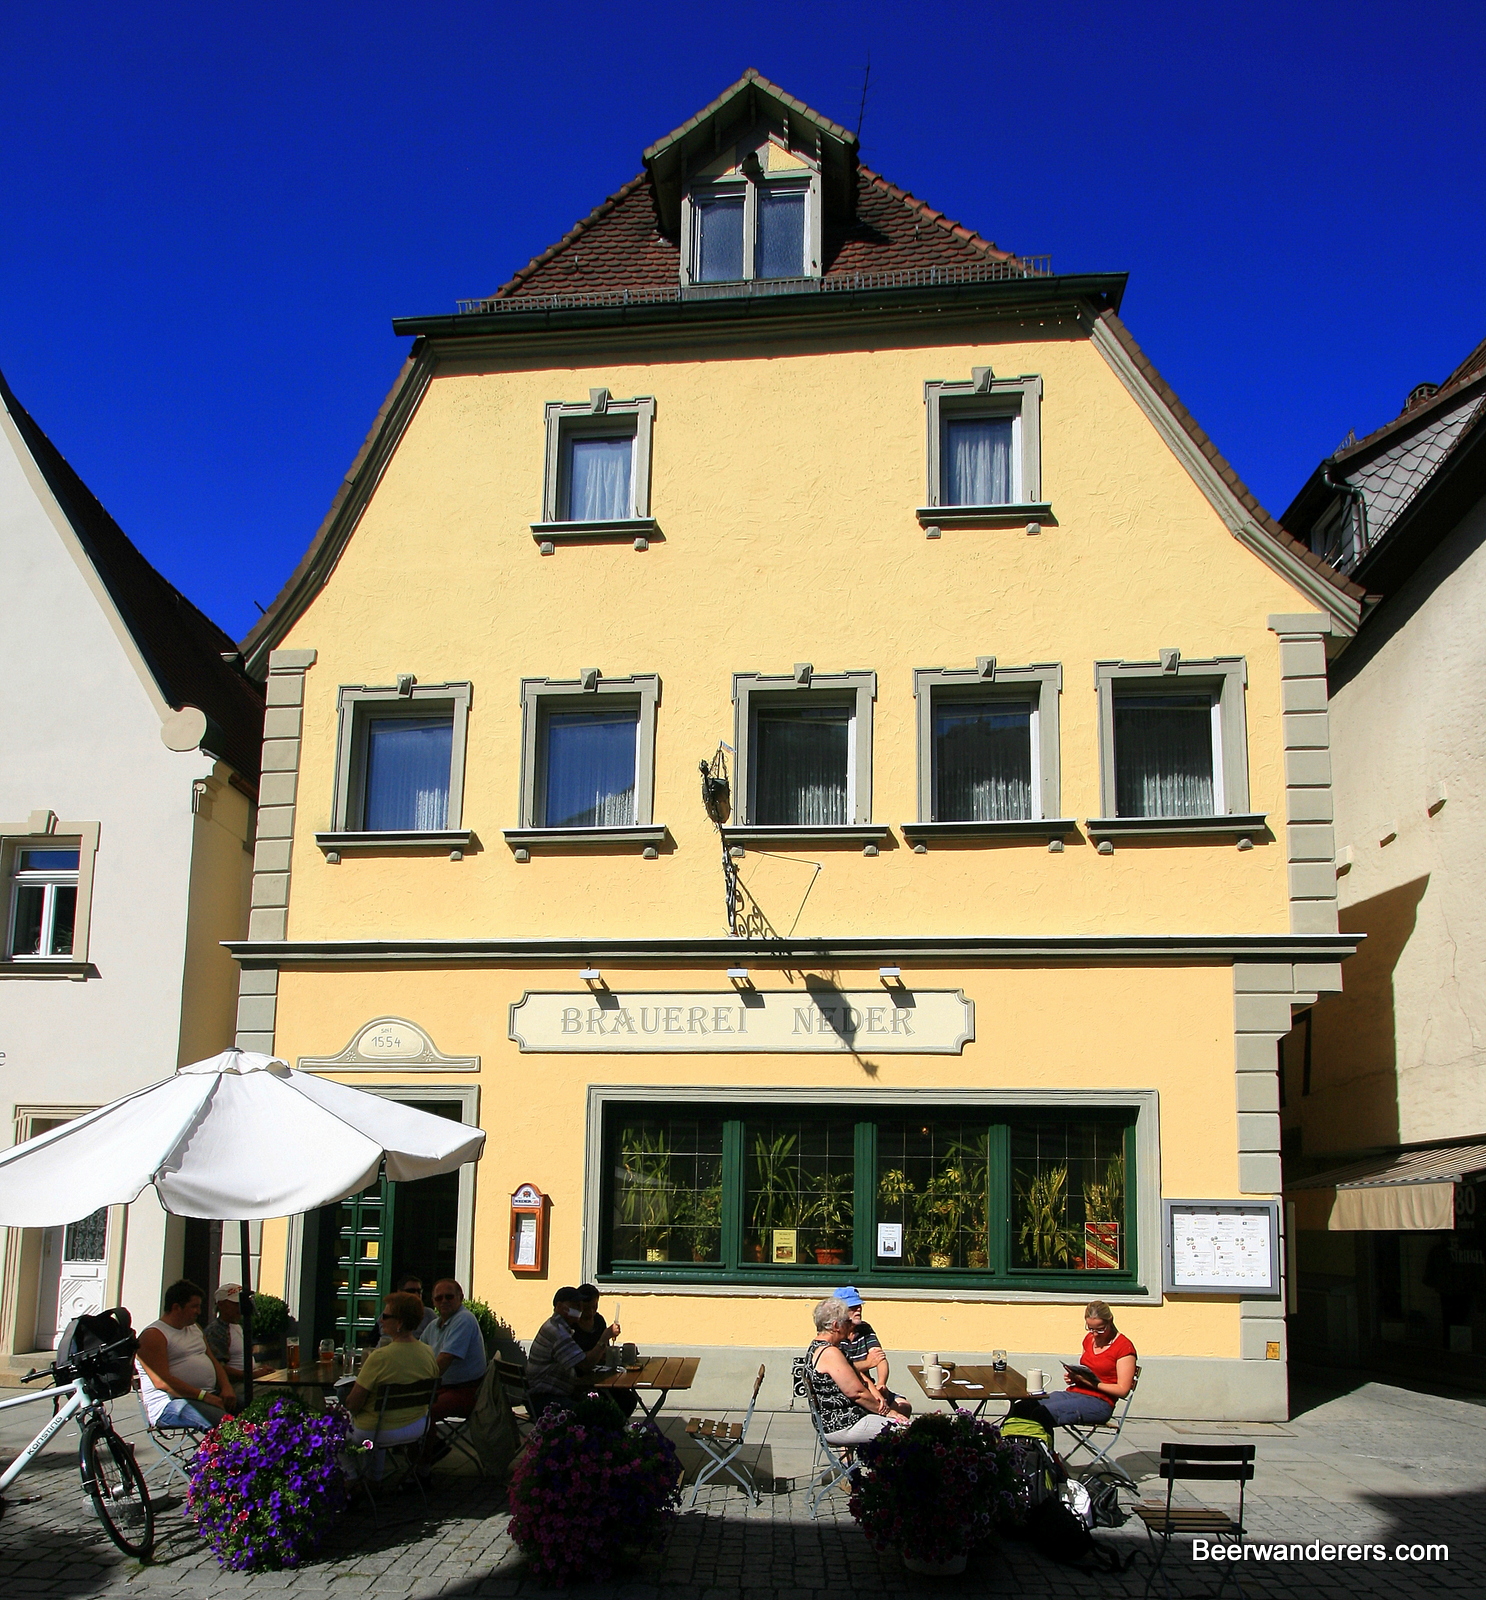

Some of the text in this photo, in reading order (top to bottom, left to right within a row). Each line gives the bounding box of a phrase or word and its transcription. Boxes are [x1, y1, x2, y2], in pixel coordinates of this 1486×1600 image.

[561, 1006, 916, 1036] BRAUEREI NEDER
[371, 1035, 401, 1048] 1554
[1455, 1185, 1476, 1215] 80
